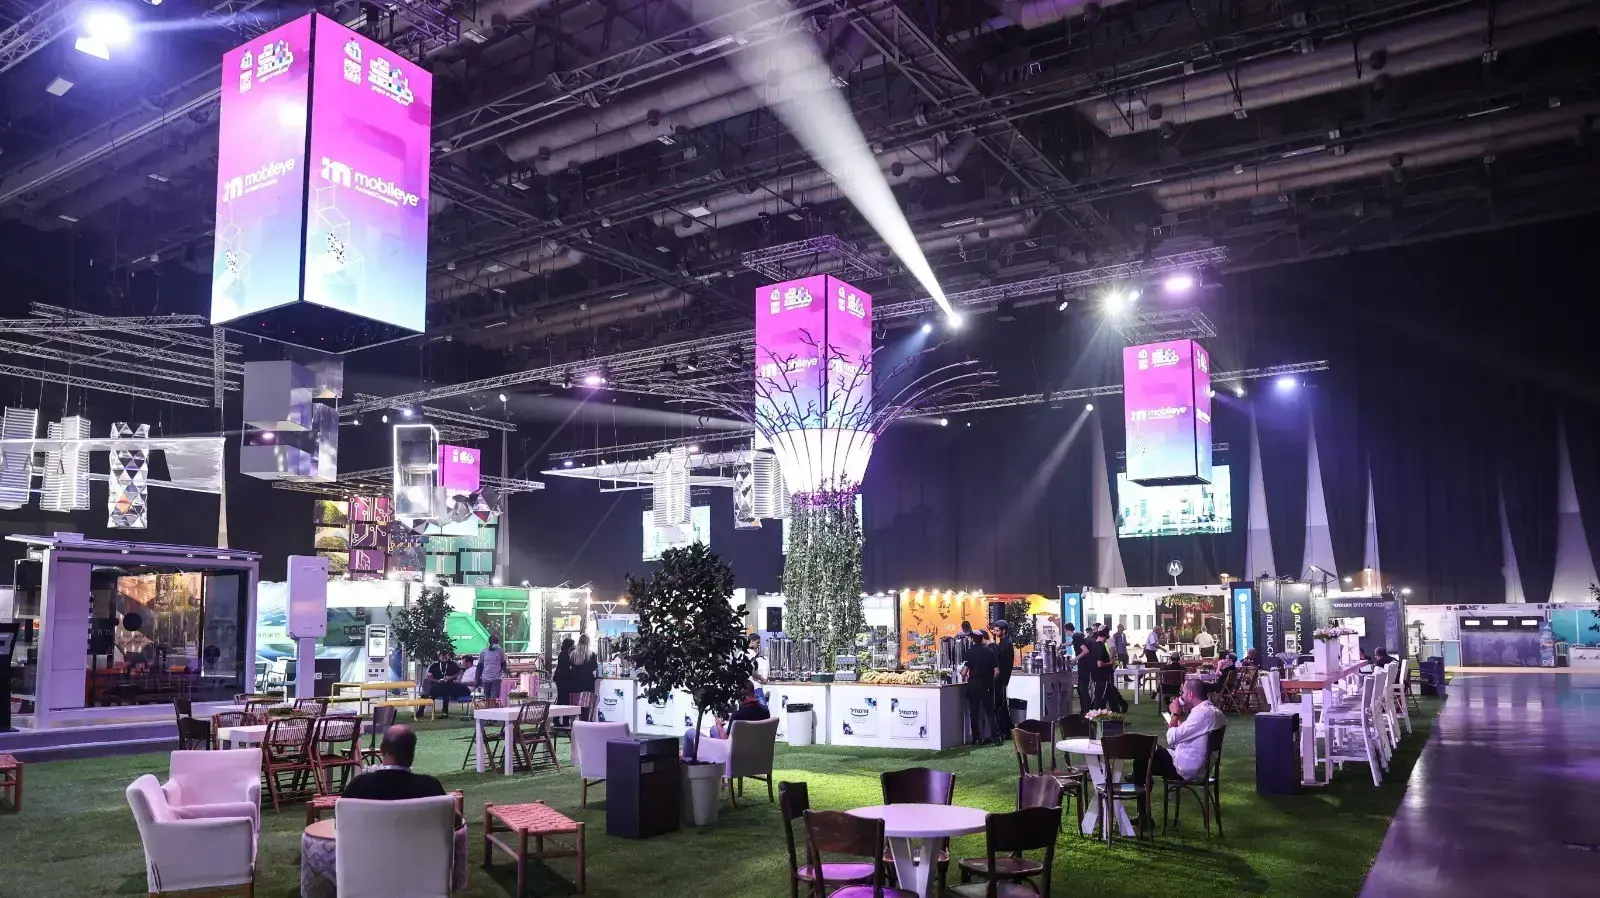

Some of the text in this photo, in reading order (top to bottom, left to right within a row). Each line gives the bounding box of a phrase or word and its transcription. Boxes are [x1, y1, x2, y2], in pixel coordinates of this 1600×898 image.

[245, 157, 295, 187] mobileye
[355, 172, 419, 207] mobileye
[1148, 406, 1188, 416] mobileye
